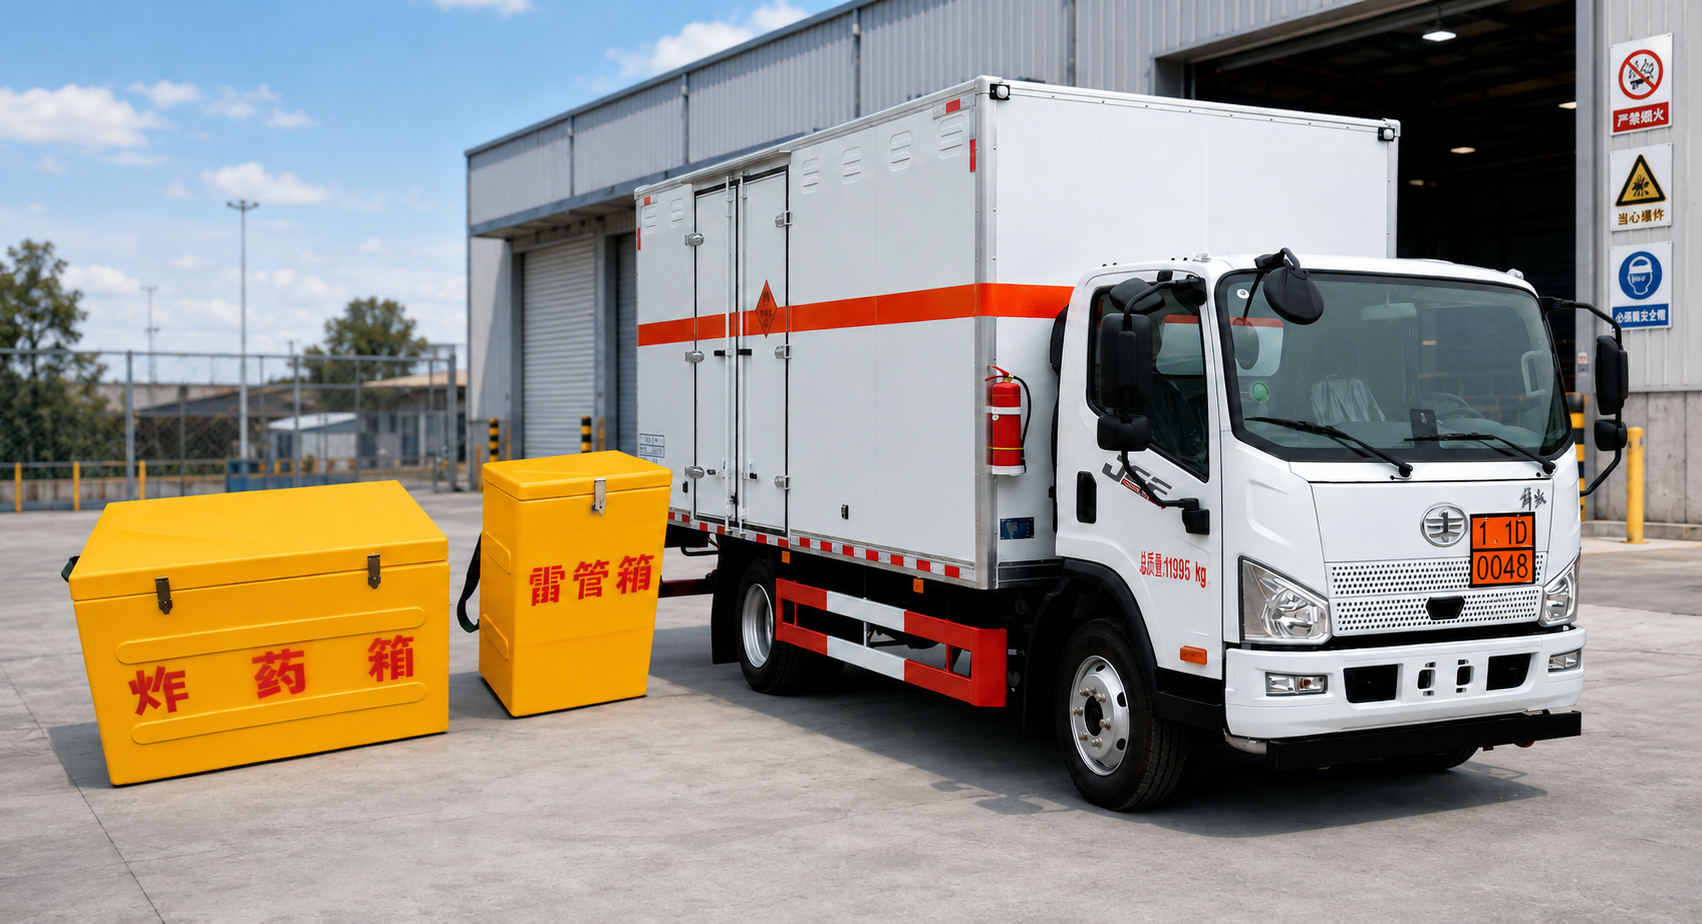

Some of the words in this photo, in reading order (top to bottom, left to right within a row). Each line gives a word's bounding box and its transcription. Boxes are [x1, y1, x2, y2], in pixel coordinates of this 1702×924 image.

[529, 554, 654, 607] 雷管箱
[1195, 561, 1207, 588] kg
[1477, 553, 1528, 580] 0048
[128, 634, 415, 717] 炸药箱
